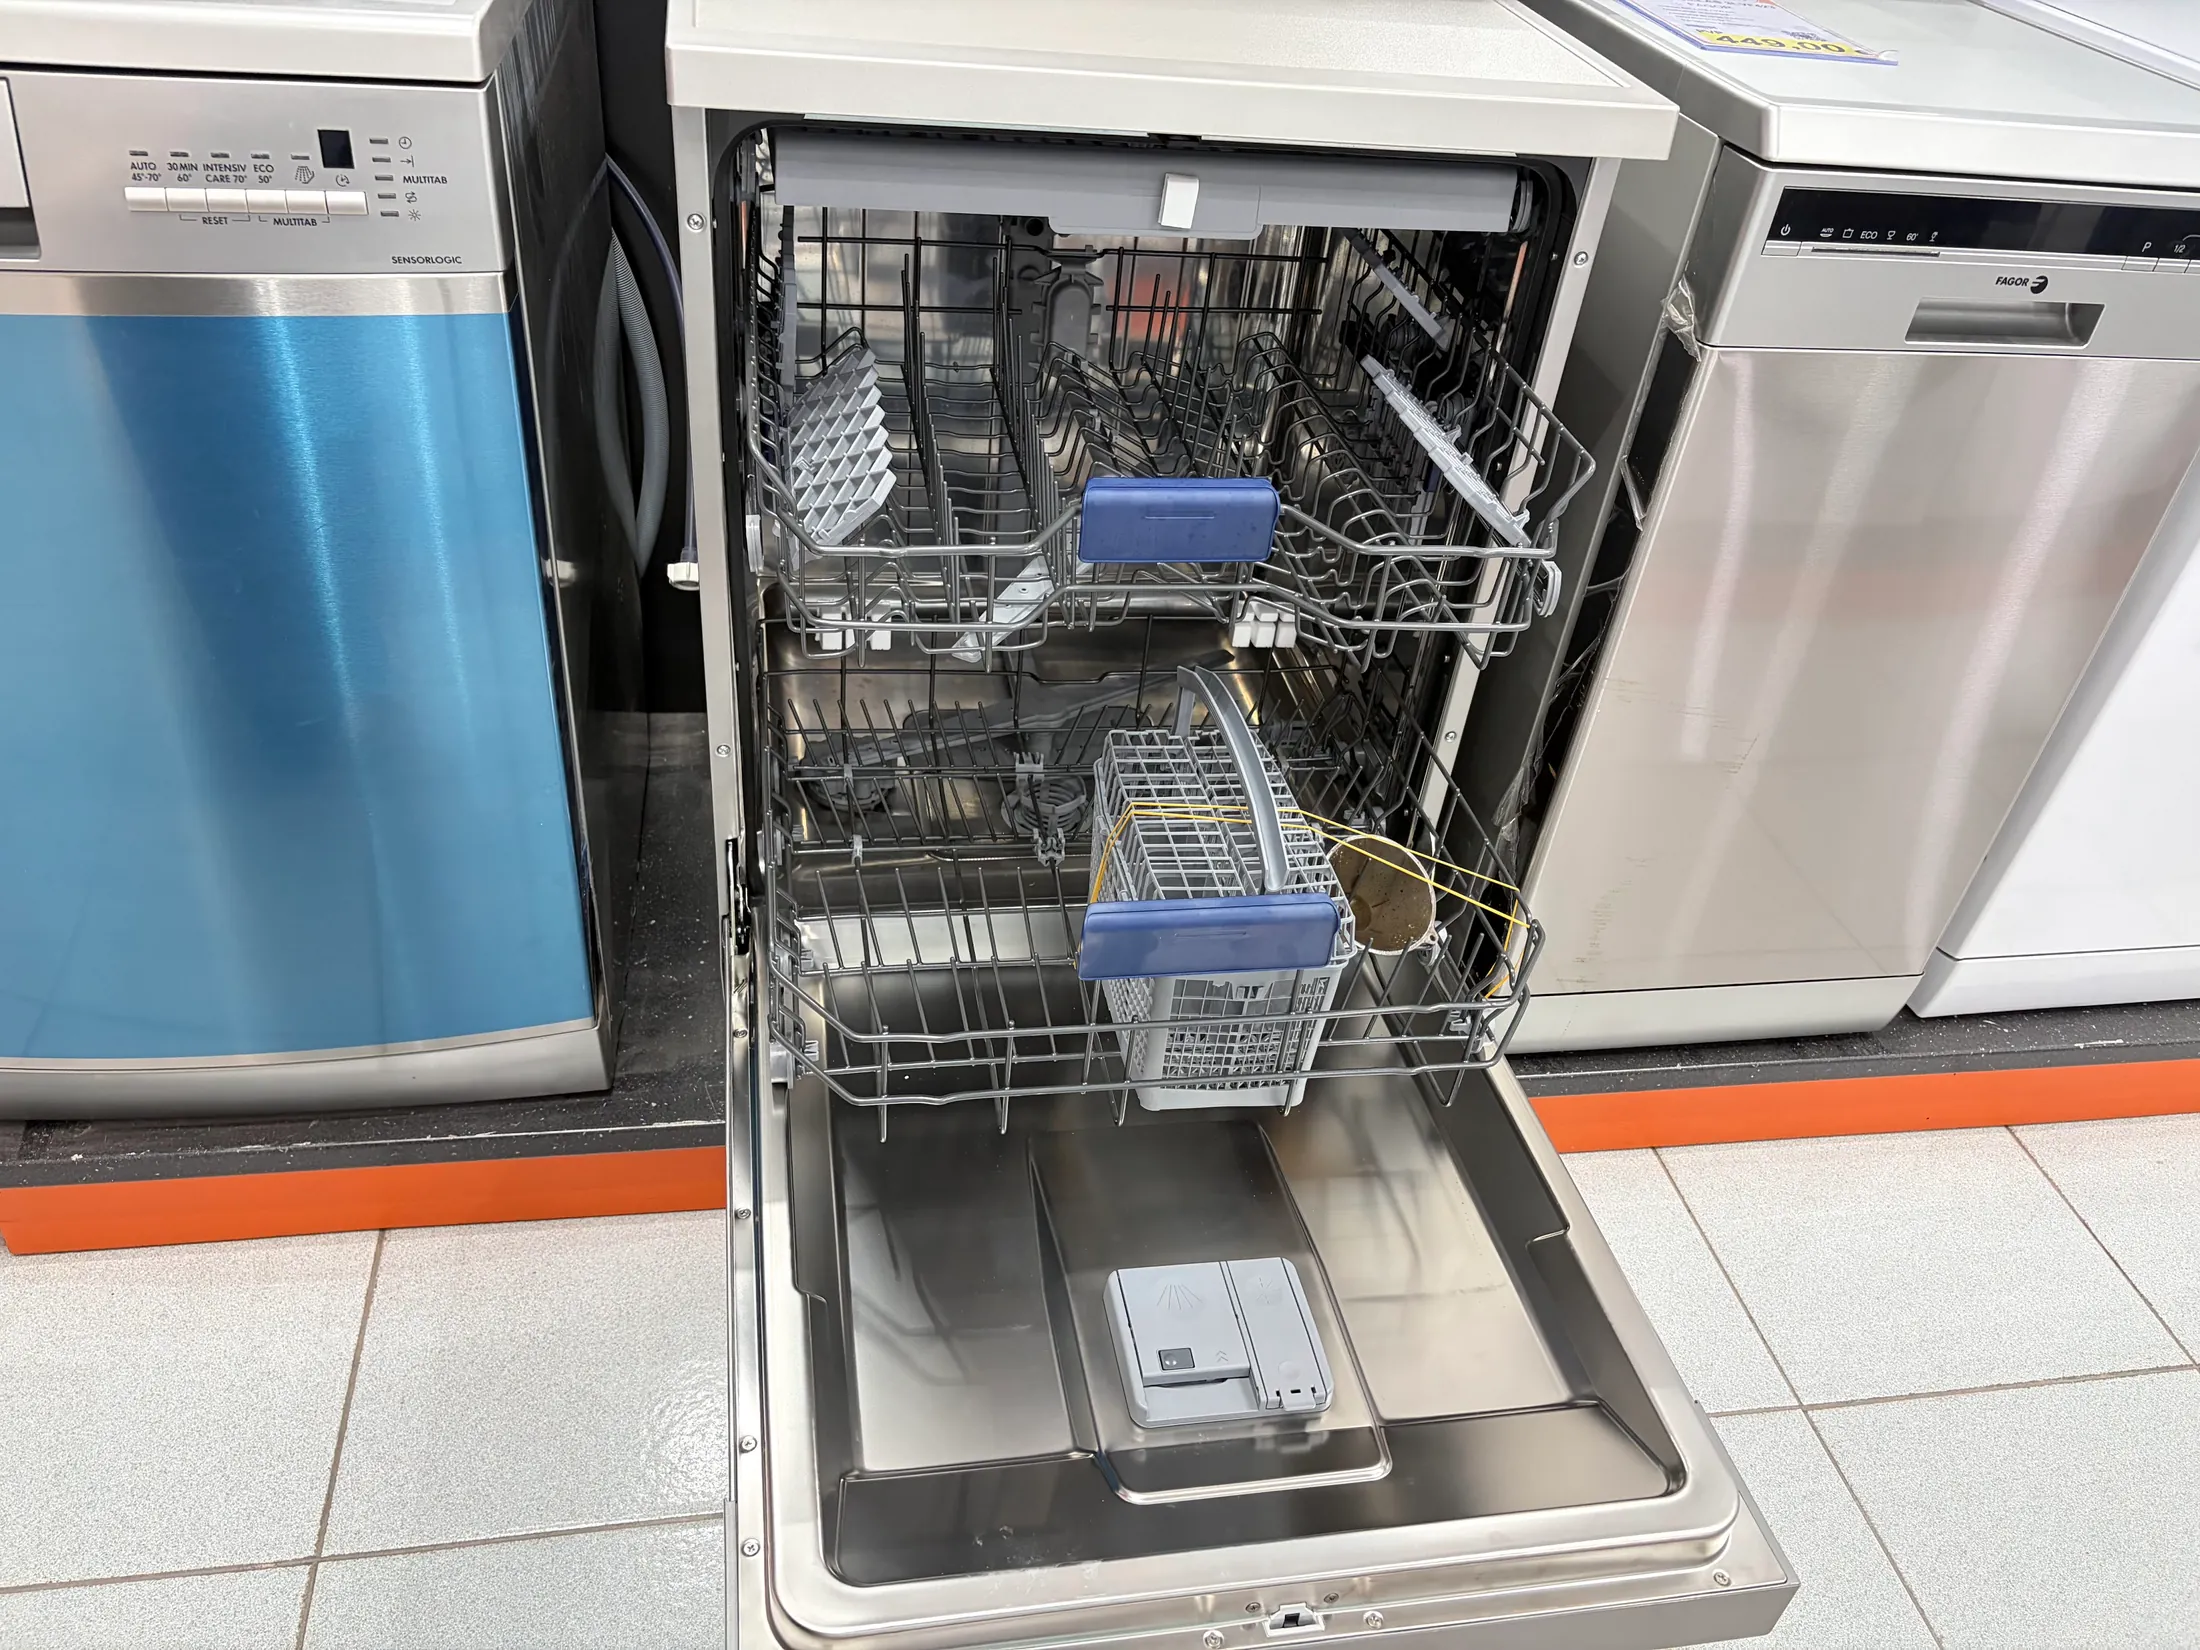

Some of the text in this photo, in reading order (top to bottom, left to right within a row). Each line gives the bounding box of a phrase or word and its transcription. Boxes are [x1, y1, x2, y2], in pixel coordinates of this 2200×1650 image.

[130, 162, 157, 171] AUTO
[167, 162, 199, 172] 30 MIN
[203, 163, 247, 172] INTENSIV
[253, 164, 275, 173] ECO
[176, 173, 192, 182] 60°
[205, 174, 248, 183] CARE 70°
[258, 175, 273, 184] 50°
[402, 175, 448, 184] MULTITAB
[202, 216, 228, 225] RESET
[273, 217, 318, 227] MULTITAB
[1860, 231, 1878, 240] ECO
[2141, 241, 2152, 253] P
[391, 255, 463, 265] SENSORLOGIC
[1995, 276, 2030, 287] FAGOR
